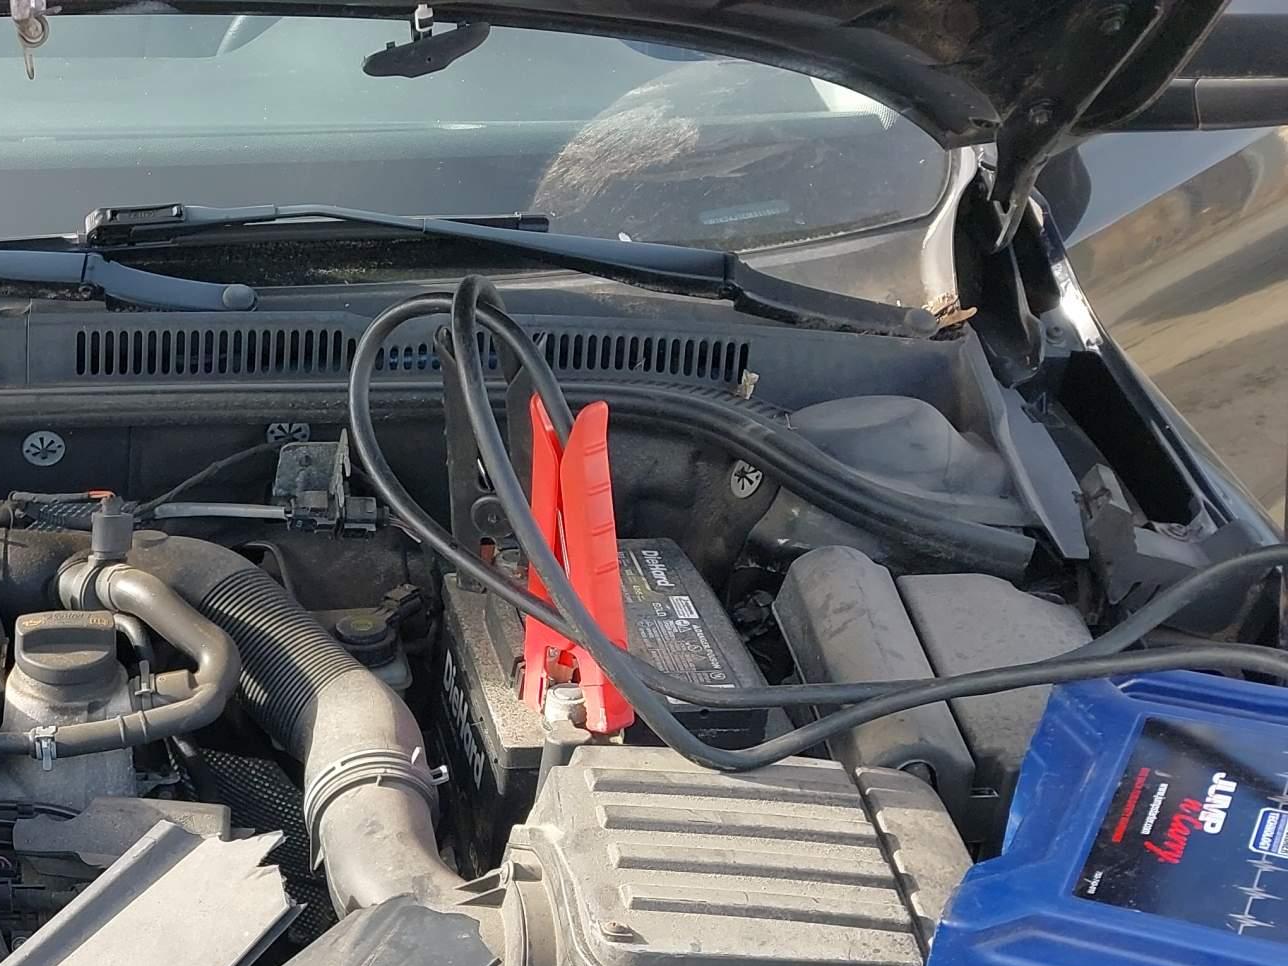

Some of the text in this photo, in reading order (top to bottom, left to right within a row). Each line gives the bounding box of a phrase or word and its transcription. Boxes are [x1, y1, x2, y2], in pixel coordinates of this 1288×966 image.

[642, 550, 675, 587] DieHard
[443, 648, 485, 791] DieHard
[1199, 772, 1237, 834] JUMP
